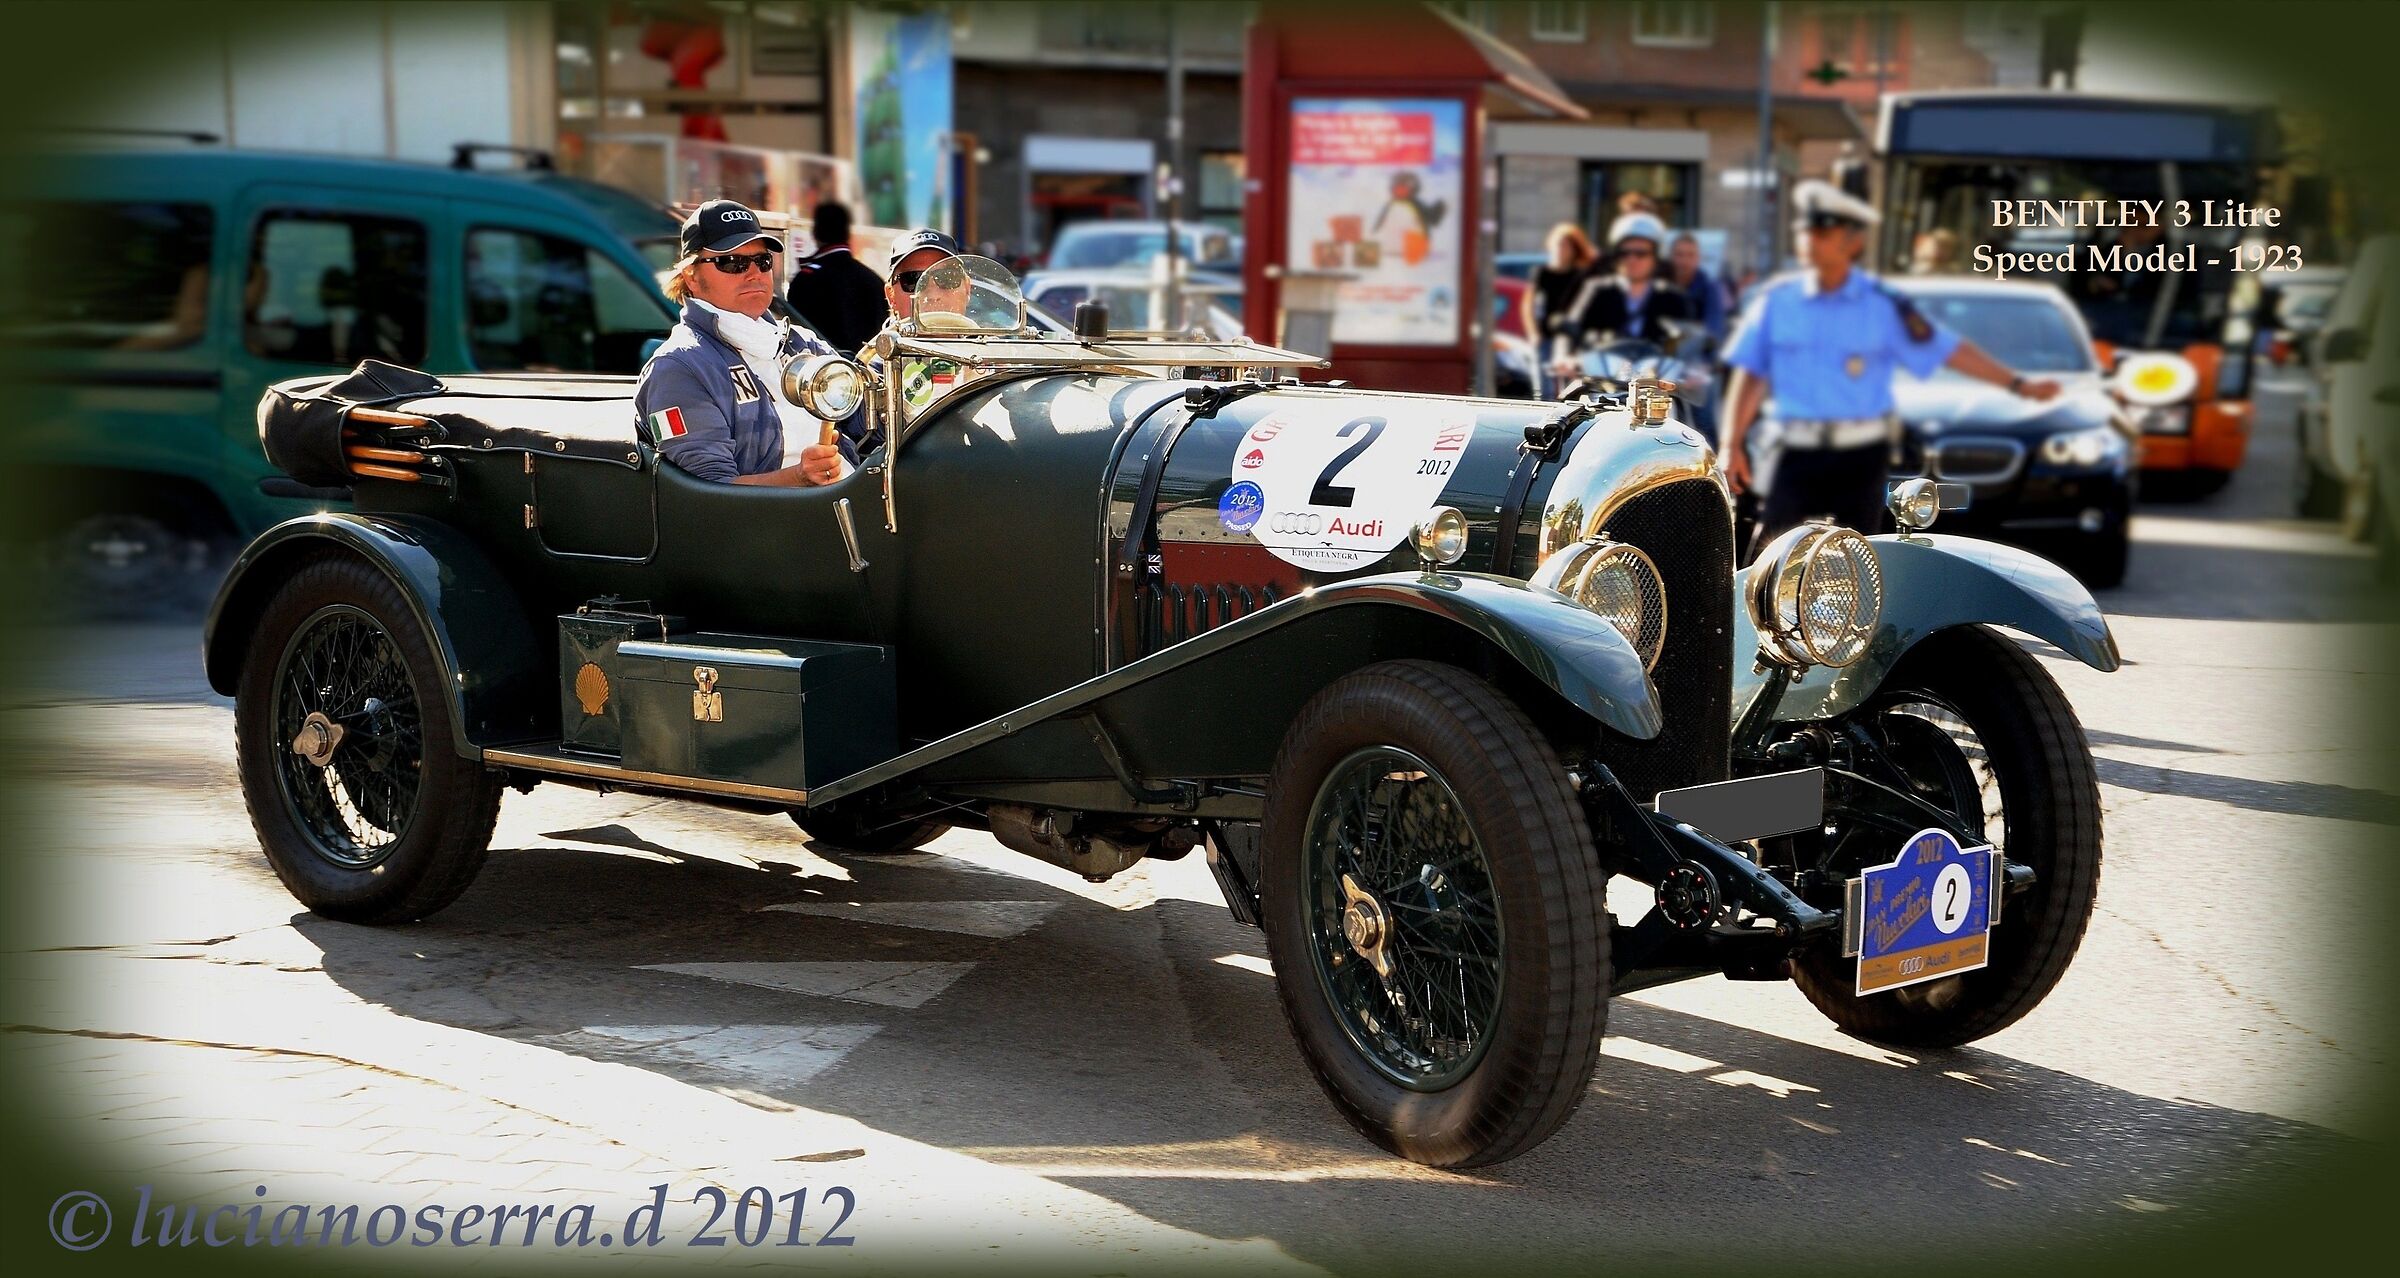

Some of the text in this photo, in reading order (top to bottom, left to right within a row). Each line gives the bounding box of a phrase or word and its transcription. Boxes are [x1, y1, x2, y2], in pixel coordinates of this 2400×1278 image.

[1241, 455, 1264, 467] aido
[1308, 415, 1389, 508] 2
[1416, 459, 1451, 476] 2012
[1230, 493, 1257, 506] 2012
[1225, 518, 1252, 532] PASSED
[1327, 516, 1383, 537] Audi
[1291, 548, 1359, 561] ETIQUETA NEGRA
[1916, 837, 1944, 865] 2012
[1944, 877, 1955, 921] 2
[1926, 954, 1951, 968] Audi
